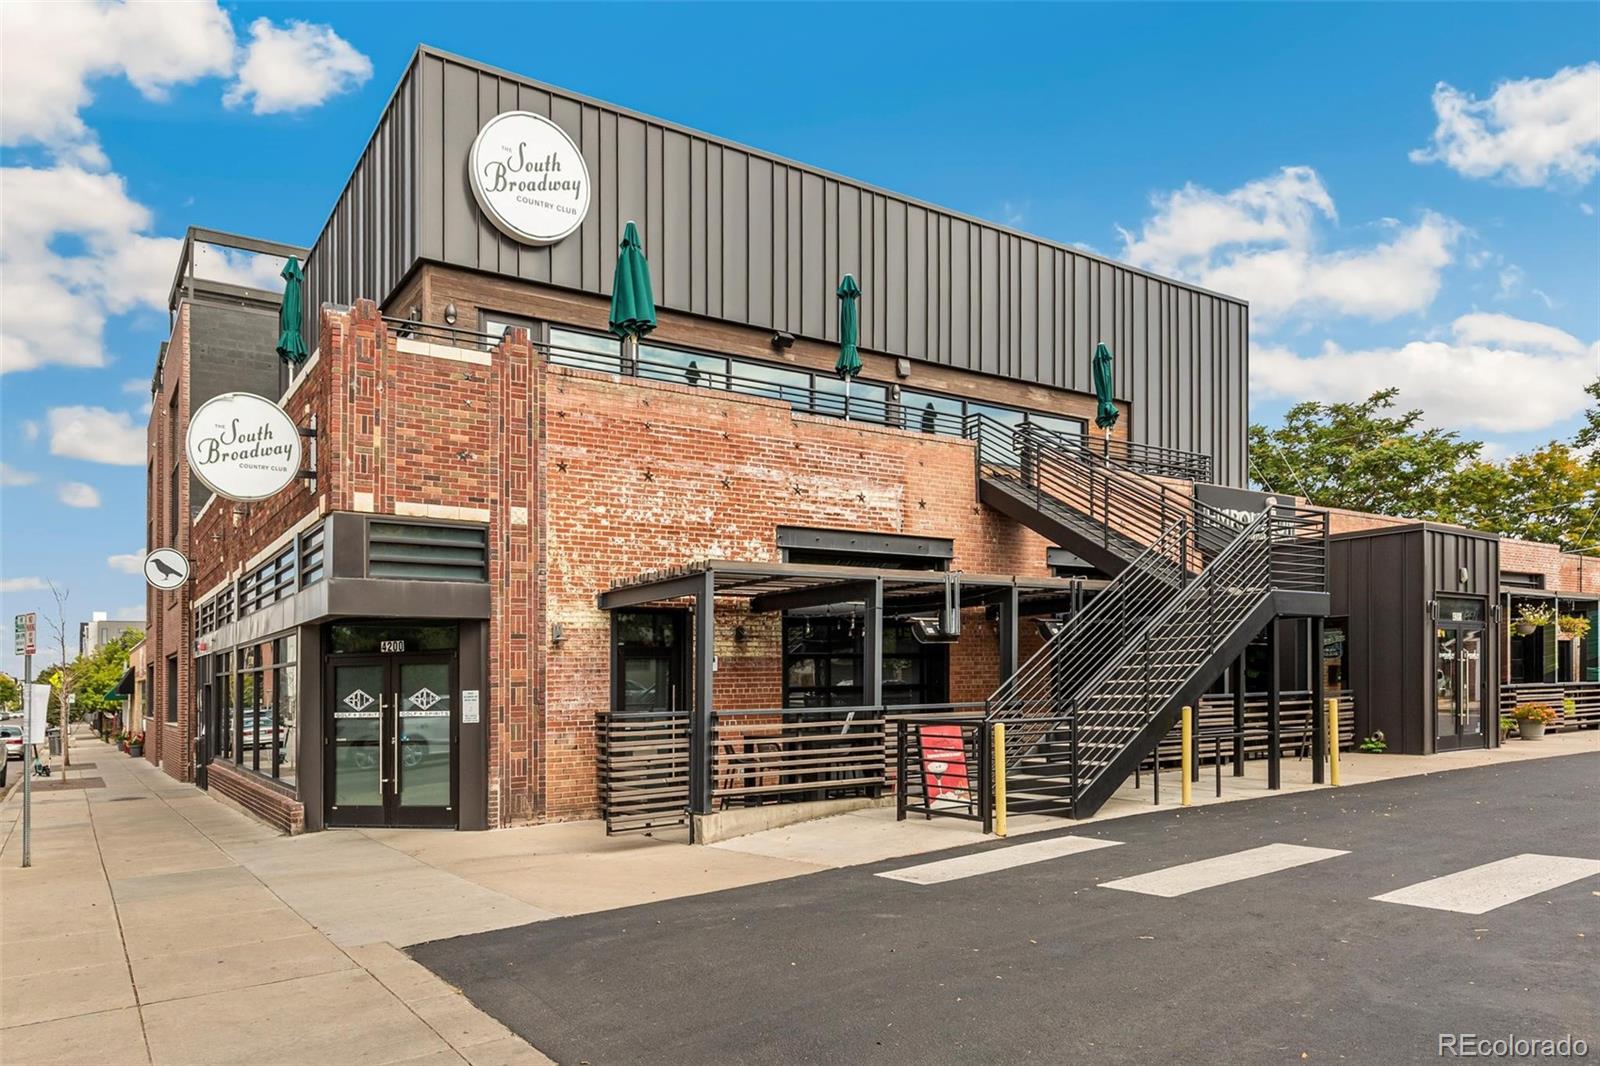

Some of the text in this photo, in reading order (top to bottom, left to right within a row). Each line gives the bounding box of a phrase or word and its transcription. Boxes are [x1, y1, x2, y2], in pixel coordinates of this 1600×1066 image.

[501, 145, 512, 153] THE
[507, 142, 561, 172] South
[484, 161, 581, 200] Broadway
[516, 195, 577, 215] COUNTRY CLUB
[220, 418, 273, 445] South
[198, 437, 292, 465] Broadway
[239, 462, 269, 471] COUNTRY
[380, 640, 404, 652] 4200
